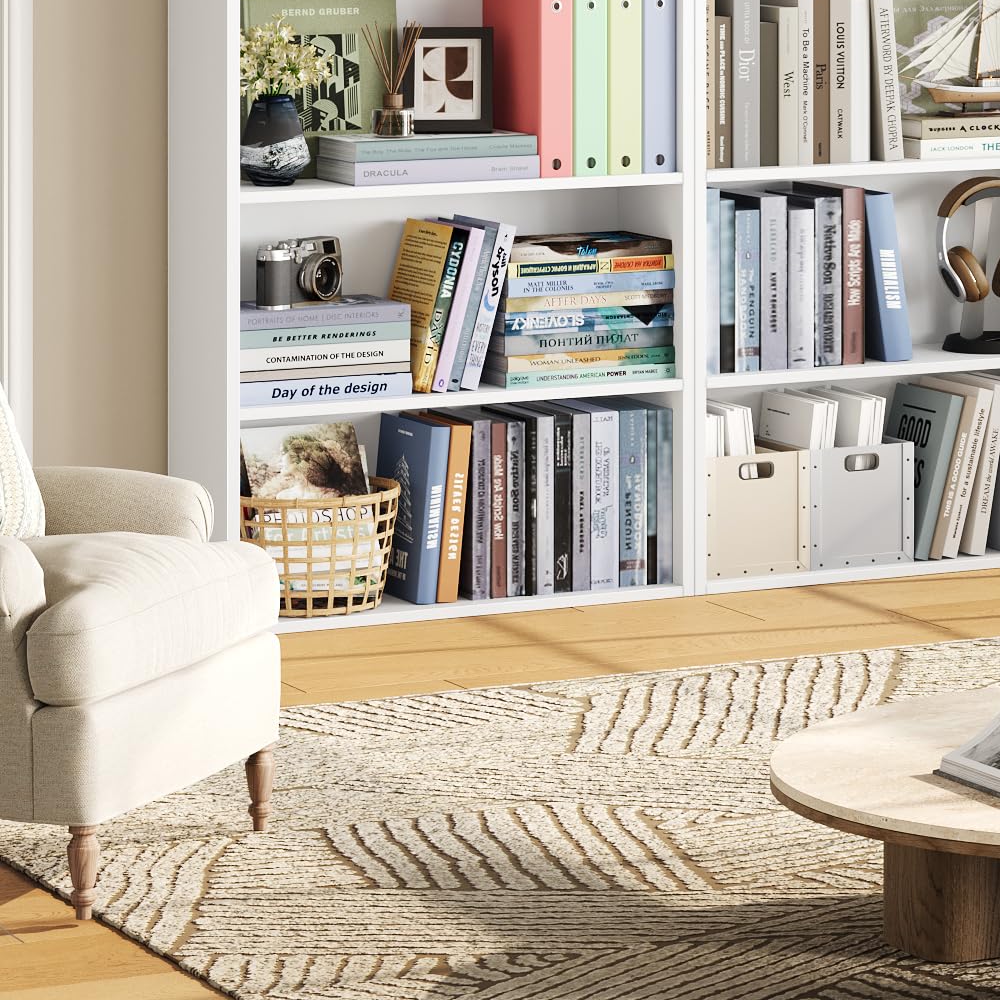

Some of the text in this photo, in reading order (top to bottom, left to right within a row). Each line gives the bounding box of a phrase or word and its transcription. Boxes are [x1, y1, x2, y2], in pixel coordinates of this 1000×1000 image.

[282, 8, 360, 17] BERND GRUBER
[802, 28, 810, 38] To
[802, 40, 810, 52] Be
[836, 22, 845, 89] LOUIS VUITTON
[738, 48, 756, 82] Dior
[784, 71, 794, 98] West
[802, 61, 810, 96] Machine
[816, 64, 827, 90] Paris
[879, 8, 898, 150] AFTERWORD BY DEEPAK CHOPRA
[982, 143, 1000, 152] THE
[363, 170, 408, 178] DRACULA
[823, 224, 836, 284] Native Son
[440, 242, 464, 298] CYDONIA
[491, 246, 505, 298] bryson
[880, 249, 901, 309] MINIMALISM
[544, 296, 607, 308] AFTER DAYS
[512, 315, 584, 330] SLOVENKY
[286, 334, 318, 342] BETTER
[321, 330, 376, 339] RENDERINGS
[423, 309, 442, 366] DAVID
[539, 334, 638, 348] ПОНТИЙ ПИЛАТ
[266, 350, 384, 364] CONTAMINATION OF THE DESIGN
[536, 374, 579, 382] UNDERSTANDING
[272, 382, 388, 400] Day of the design
[898, 414, 932, 448] GOOD
